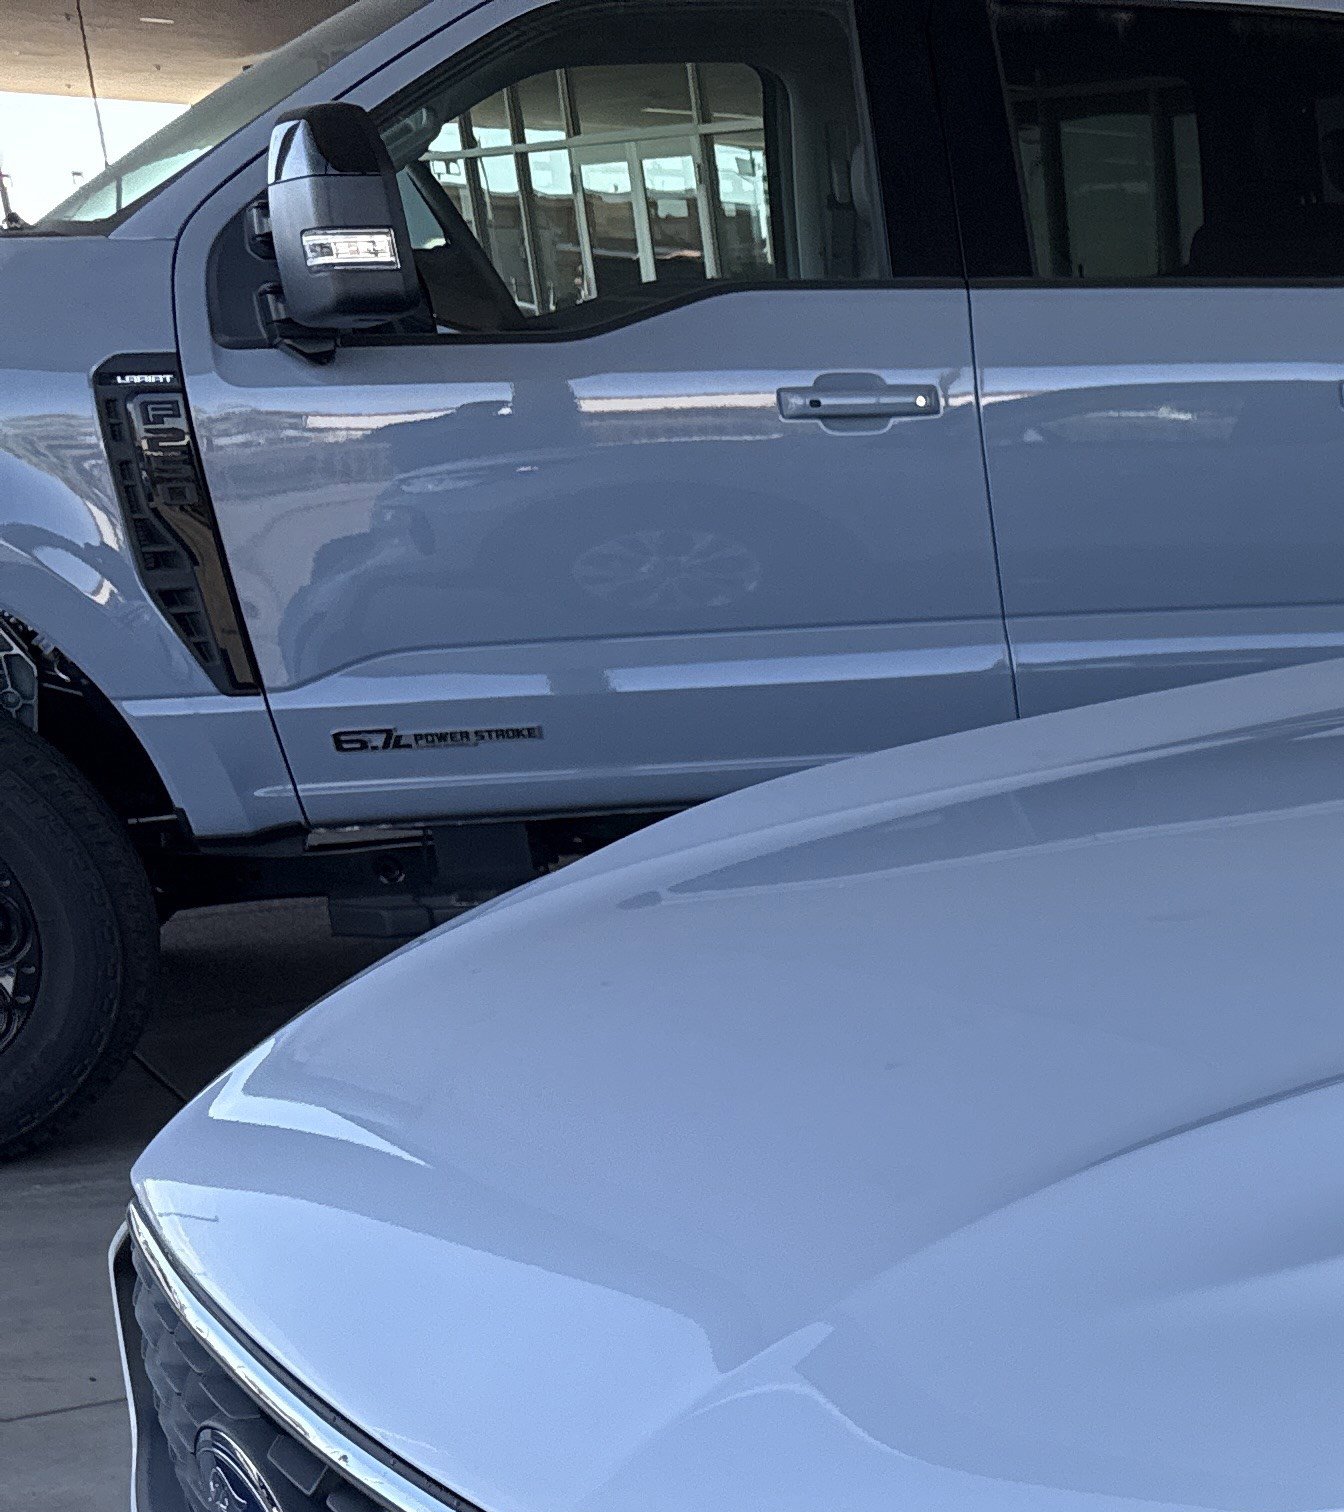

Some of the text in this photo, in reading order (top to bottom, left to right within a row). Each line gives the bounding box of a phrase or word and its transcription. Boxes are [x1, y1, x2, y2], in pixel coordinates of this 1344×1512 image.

[116, 373, 174, 384] LARIAT
[331, 726, 538, 752] 6.7L POWER STROKE
